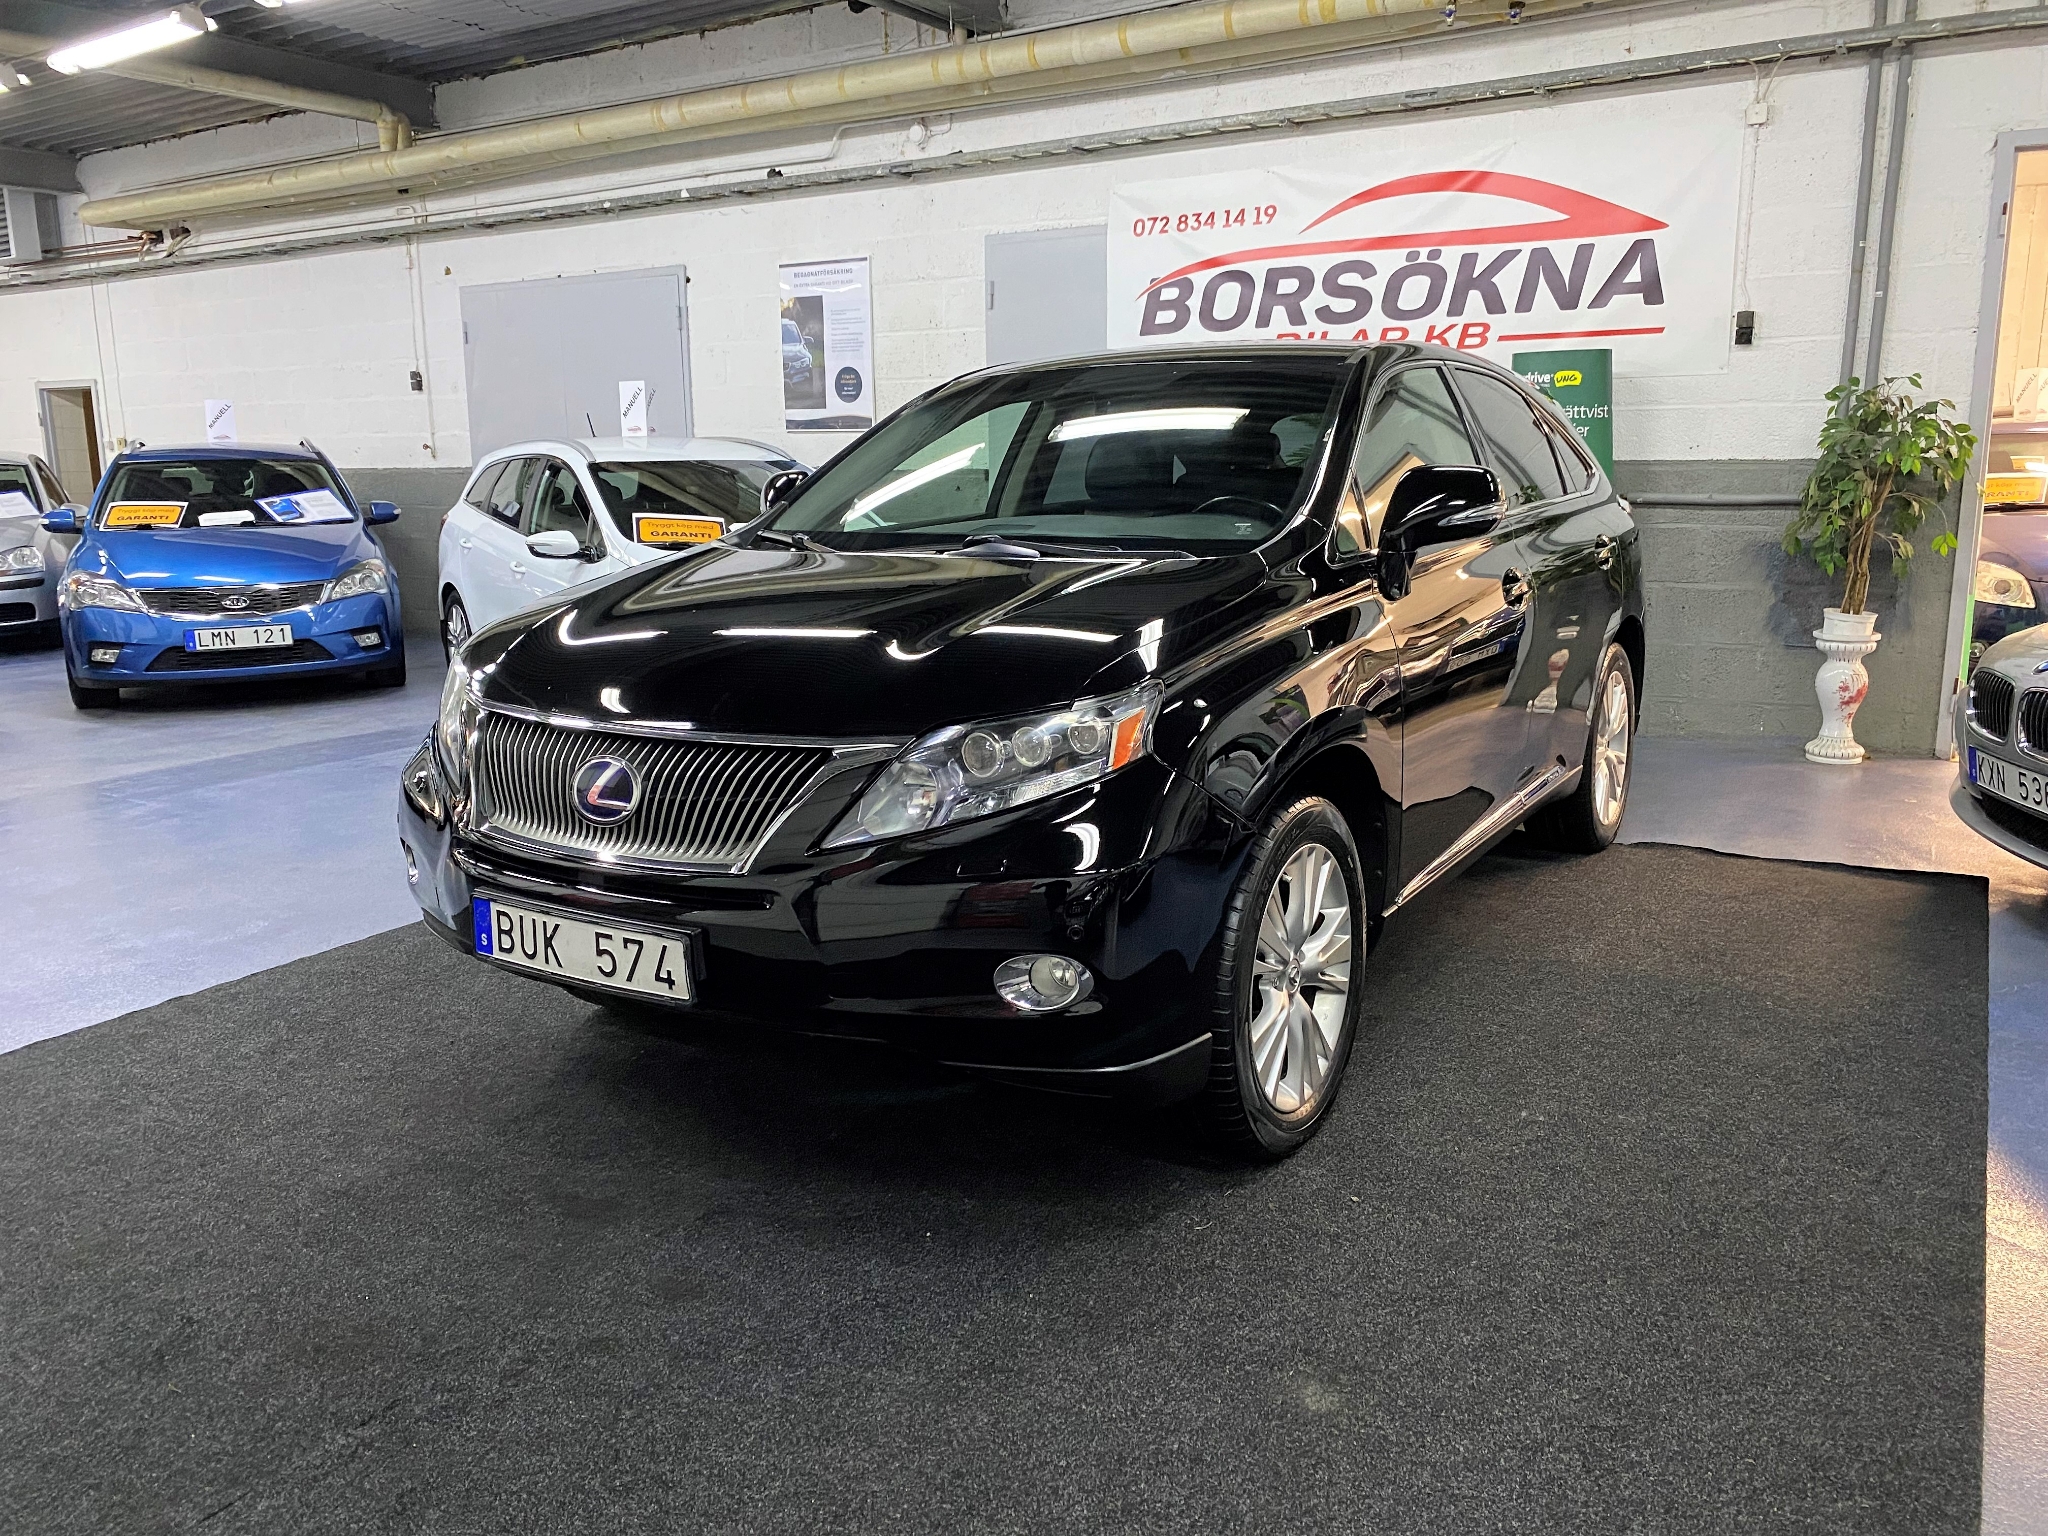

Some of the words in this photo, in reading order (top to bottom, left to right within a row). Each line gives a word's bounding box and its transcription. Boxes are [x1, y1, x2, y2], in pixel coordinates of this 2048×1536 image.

[1132, 215, 1170, 238] 072
[1176, 210, 1216, 233] 834
[1222, 208, 1246, 229] 14
[1252, 204, 1278, 226] 19
[1139, 238, 1666, 337] BORSÖKNA
[1424, 322, 1491, 350] KB
[1556, 373, 1578, 383] UNG
[2016, 373, 2038, 404] MANUELL
[622, 386, 643, 419] MANUELL
[1563, 402, 1609, 419] ättvist
[208, 403, 232, 430] MANUELL
[1986, 490, 2030, 498] RANTI
[646, 521, 675, 529] Tryggt
[676, 522, 693, 530] köp
[650, 530, 712, 539] GARANTI
[198, 630, 236, 647] LMN
[253, 627, 286, 644] 121
[1977, 754, 2006, 793] KXN
[481, 933, 488, 946] S
[495, 909, 563, 969] BUK
[594, 930, 676, 991] 574
